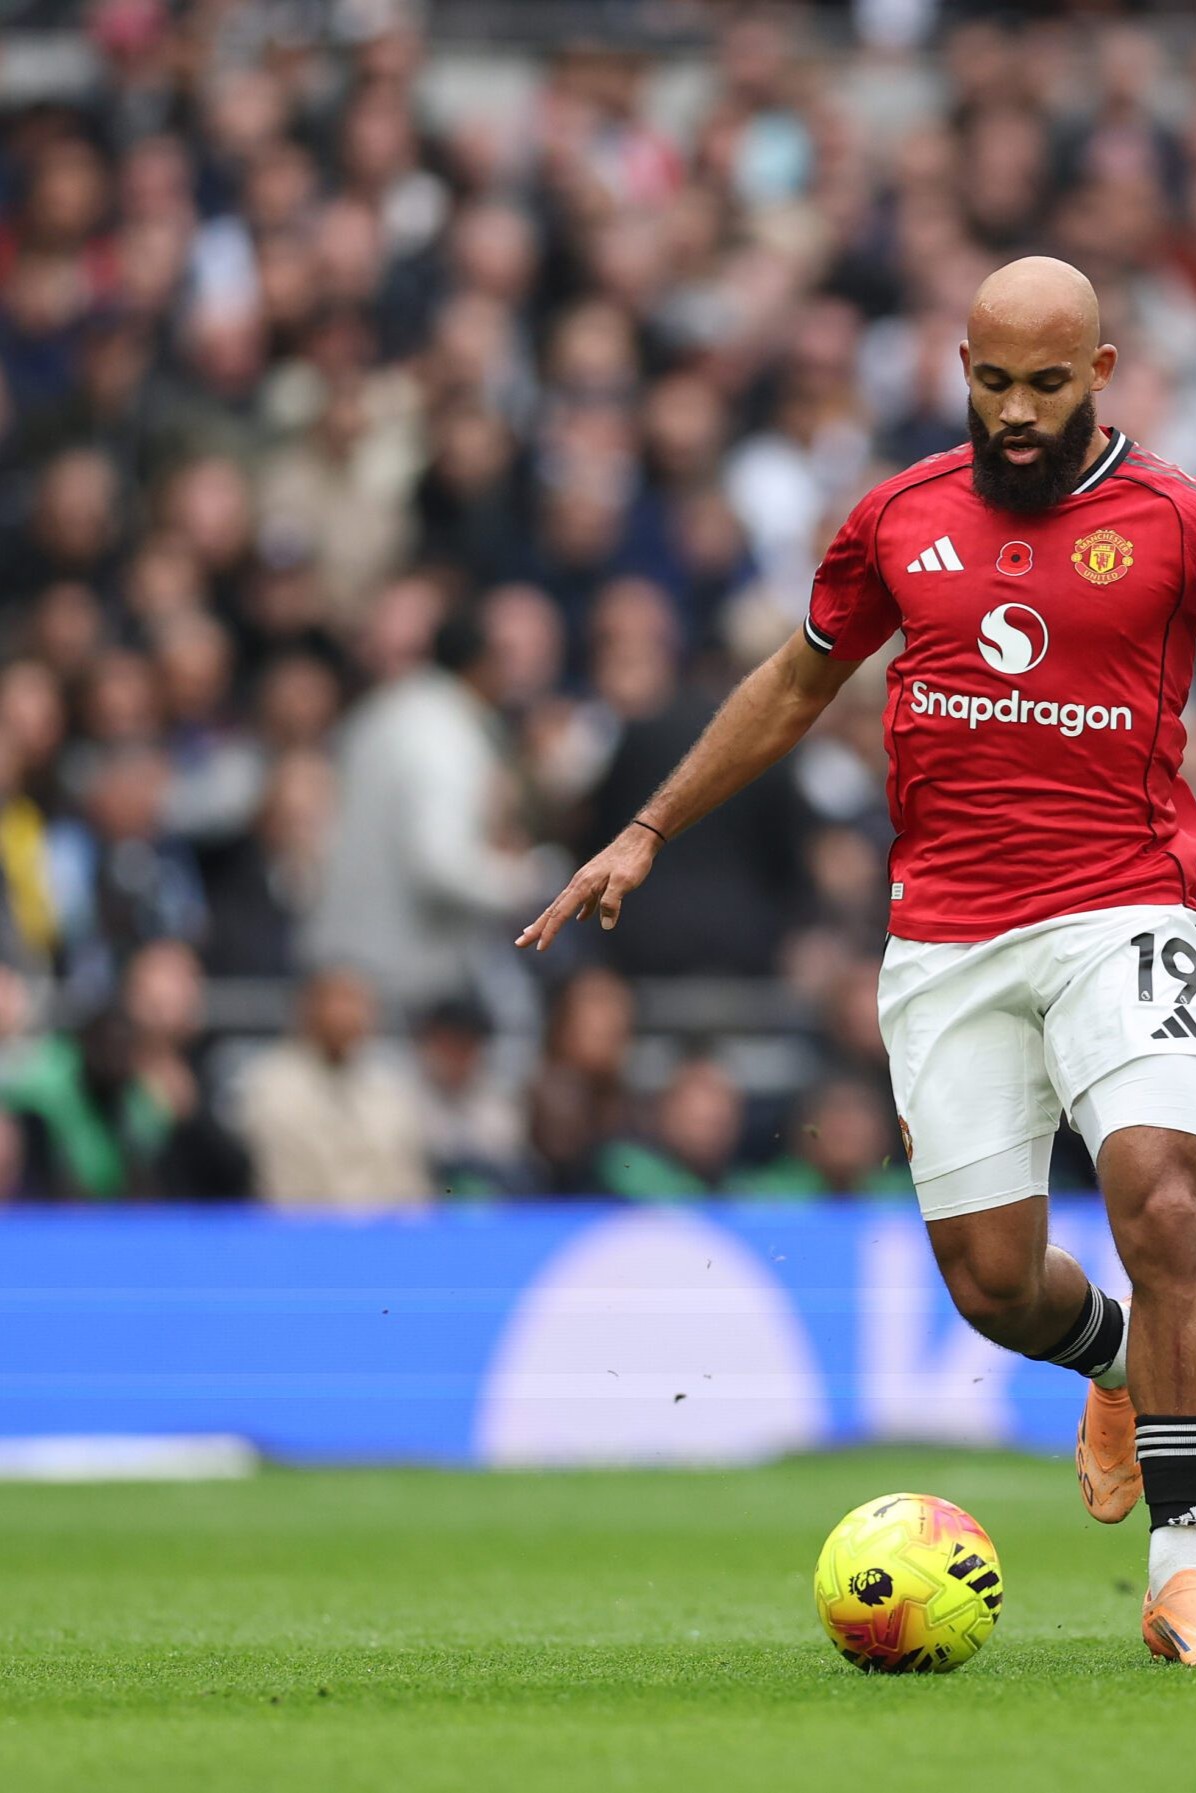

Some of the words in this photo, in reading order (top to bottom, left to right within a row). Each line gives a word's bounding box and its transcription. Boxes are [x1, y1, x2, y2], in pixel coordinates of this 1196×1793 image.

[1080, 533, 1129, 553] MANCHESTER
[1083, 569, 1119, 581] UNITED
[910, 680, 1133, 738] Snapdragon
